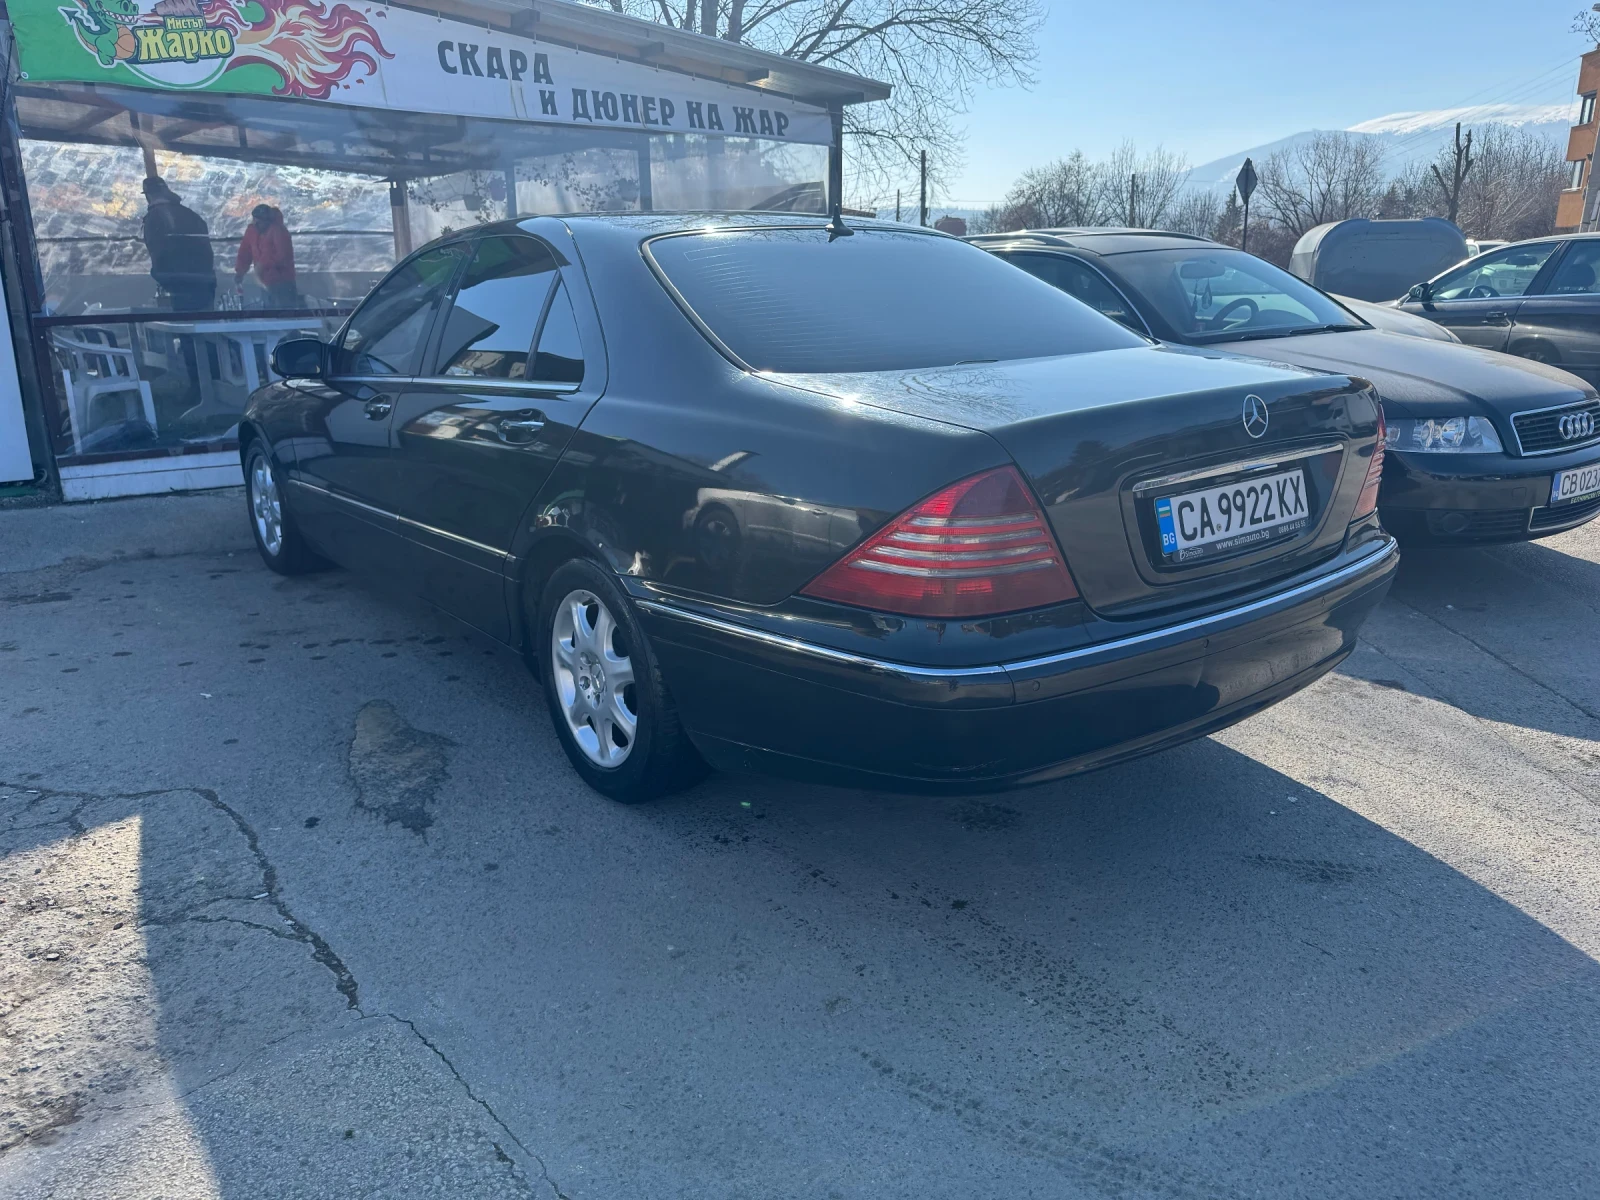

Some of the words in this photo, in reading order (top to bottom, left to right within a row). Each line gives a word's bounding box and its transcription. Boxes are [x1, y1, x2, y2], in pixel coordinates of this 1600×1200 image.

[136, 28, 231, 60] Жарко
[437, 40, 554, 85] СКАРА
[571, 88, 675, 126] ДЮНЕР
[686, 100, 724, 131] НА
[733, 106, 790, 137] ЖАР
[1162, 532, 1176, 546] BG
[1215, 530, 1270, 550] www.simauto.bg
